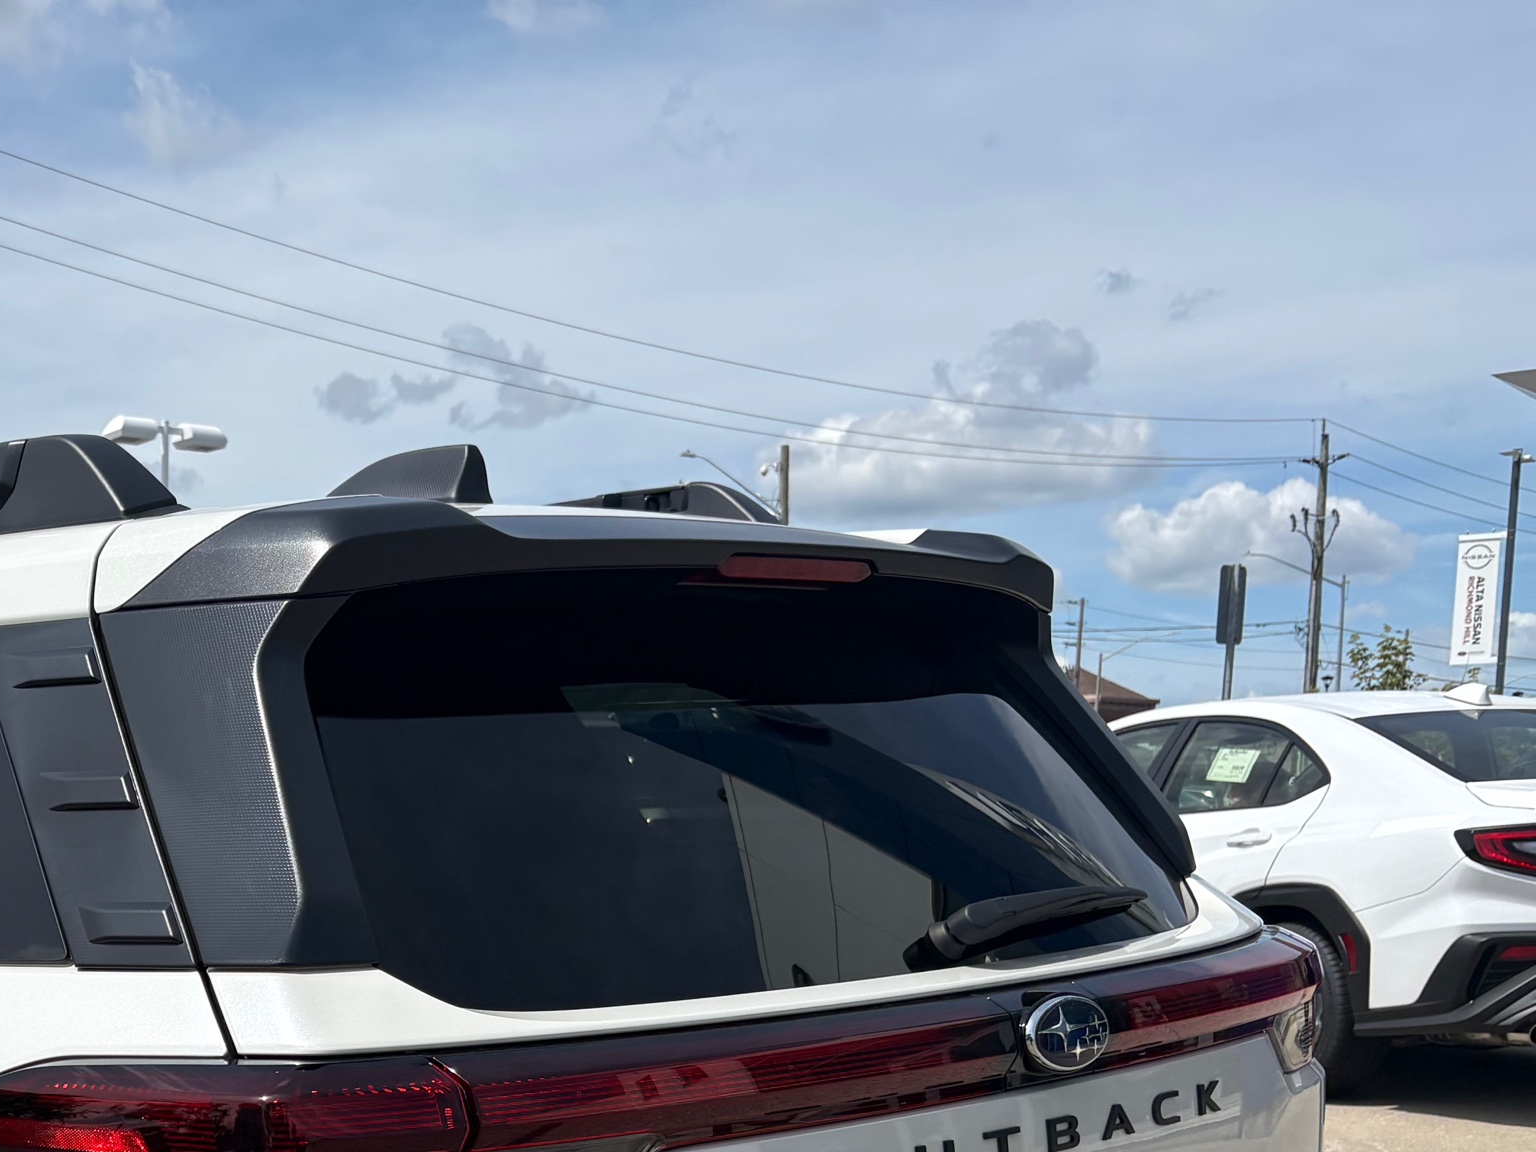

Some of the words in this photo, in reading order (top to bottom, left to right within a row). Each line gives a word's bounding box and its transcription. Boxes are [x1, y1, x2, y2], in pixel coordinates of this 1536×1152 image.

[1465, 576, 1475, 624] RICHMOND
[1475, 576, 1485, 602] ALTA
[1462, 626, 1471, 645] HILL
[1472, 605, 1483, 645] NISSAN
